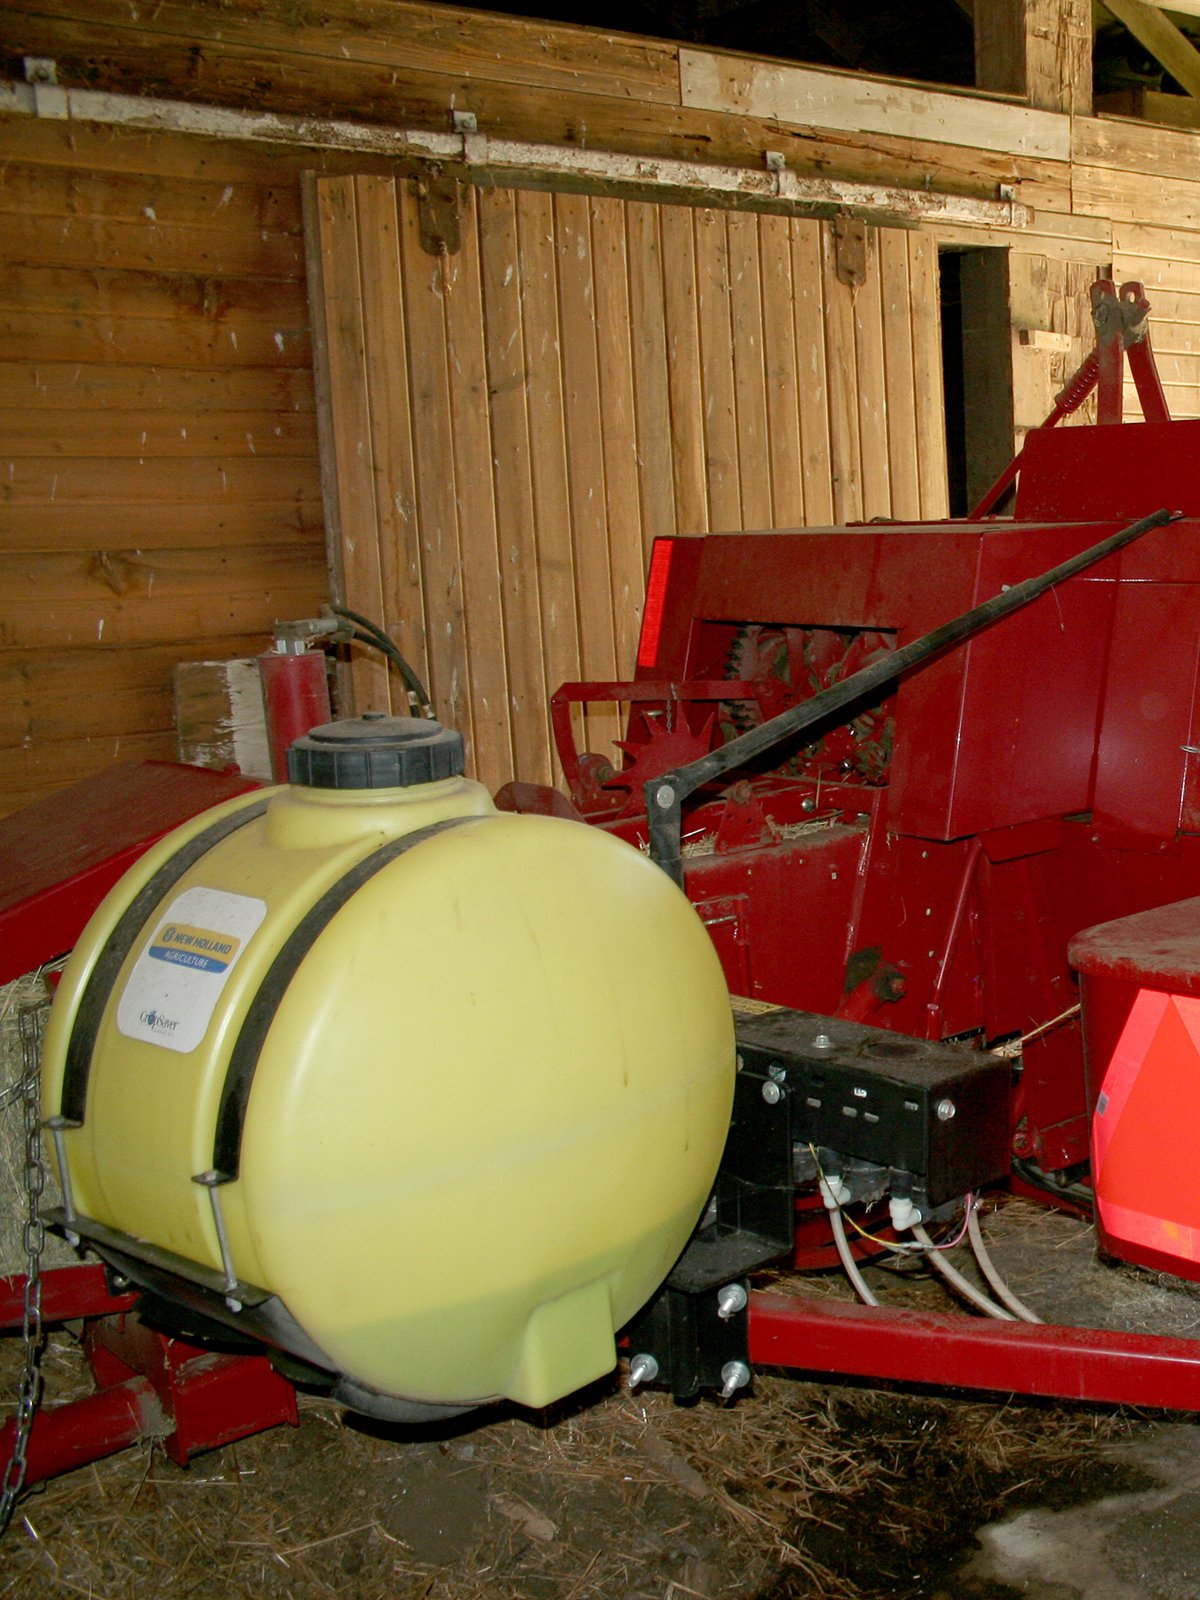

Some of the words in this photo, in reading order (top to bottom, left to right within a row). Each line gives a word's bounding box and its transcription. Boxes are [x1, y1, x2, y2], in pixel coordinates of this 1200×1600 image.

[173, 932, 193, 946] NEW
[192, 936, 232, 954] HOLLAND
[164, 950, 209, 968] AGRICULTURE
